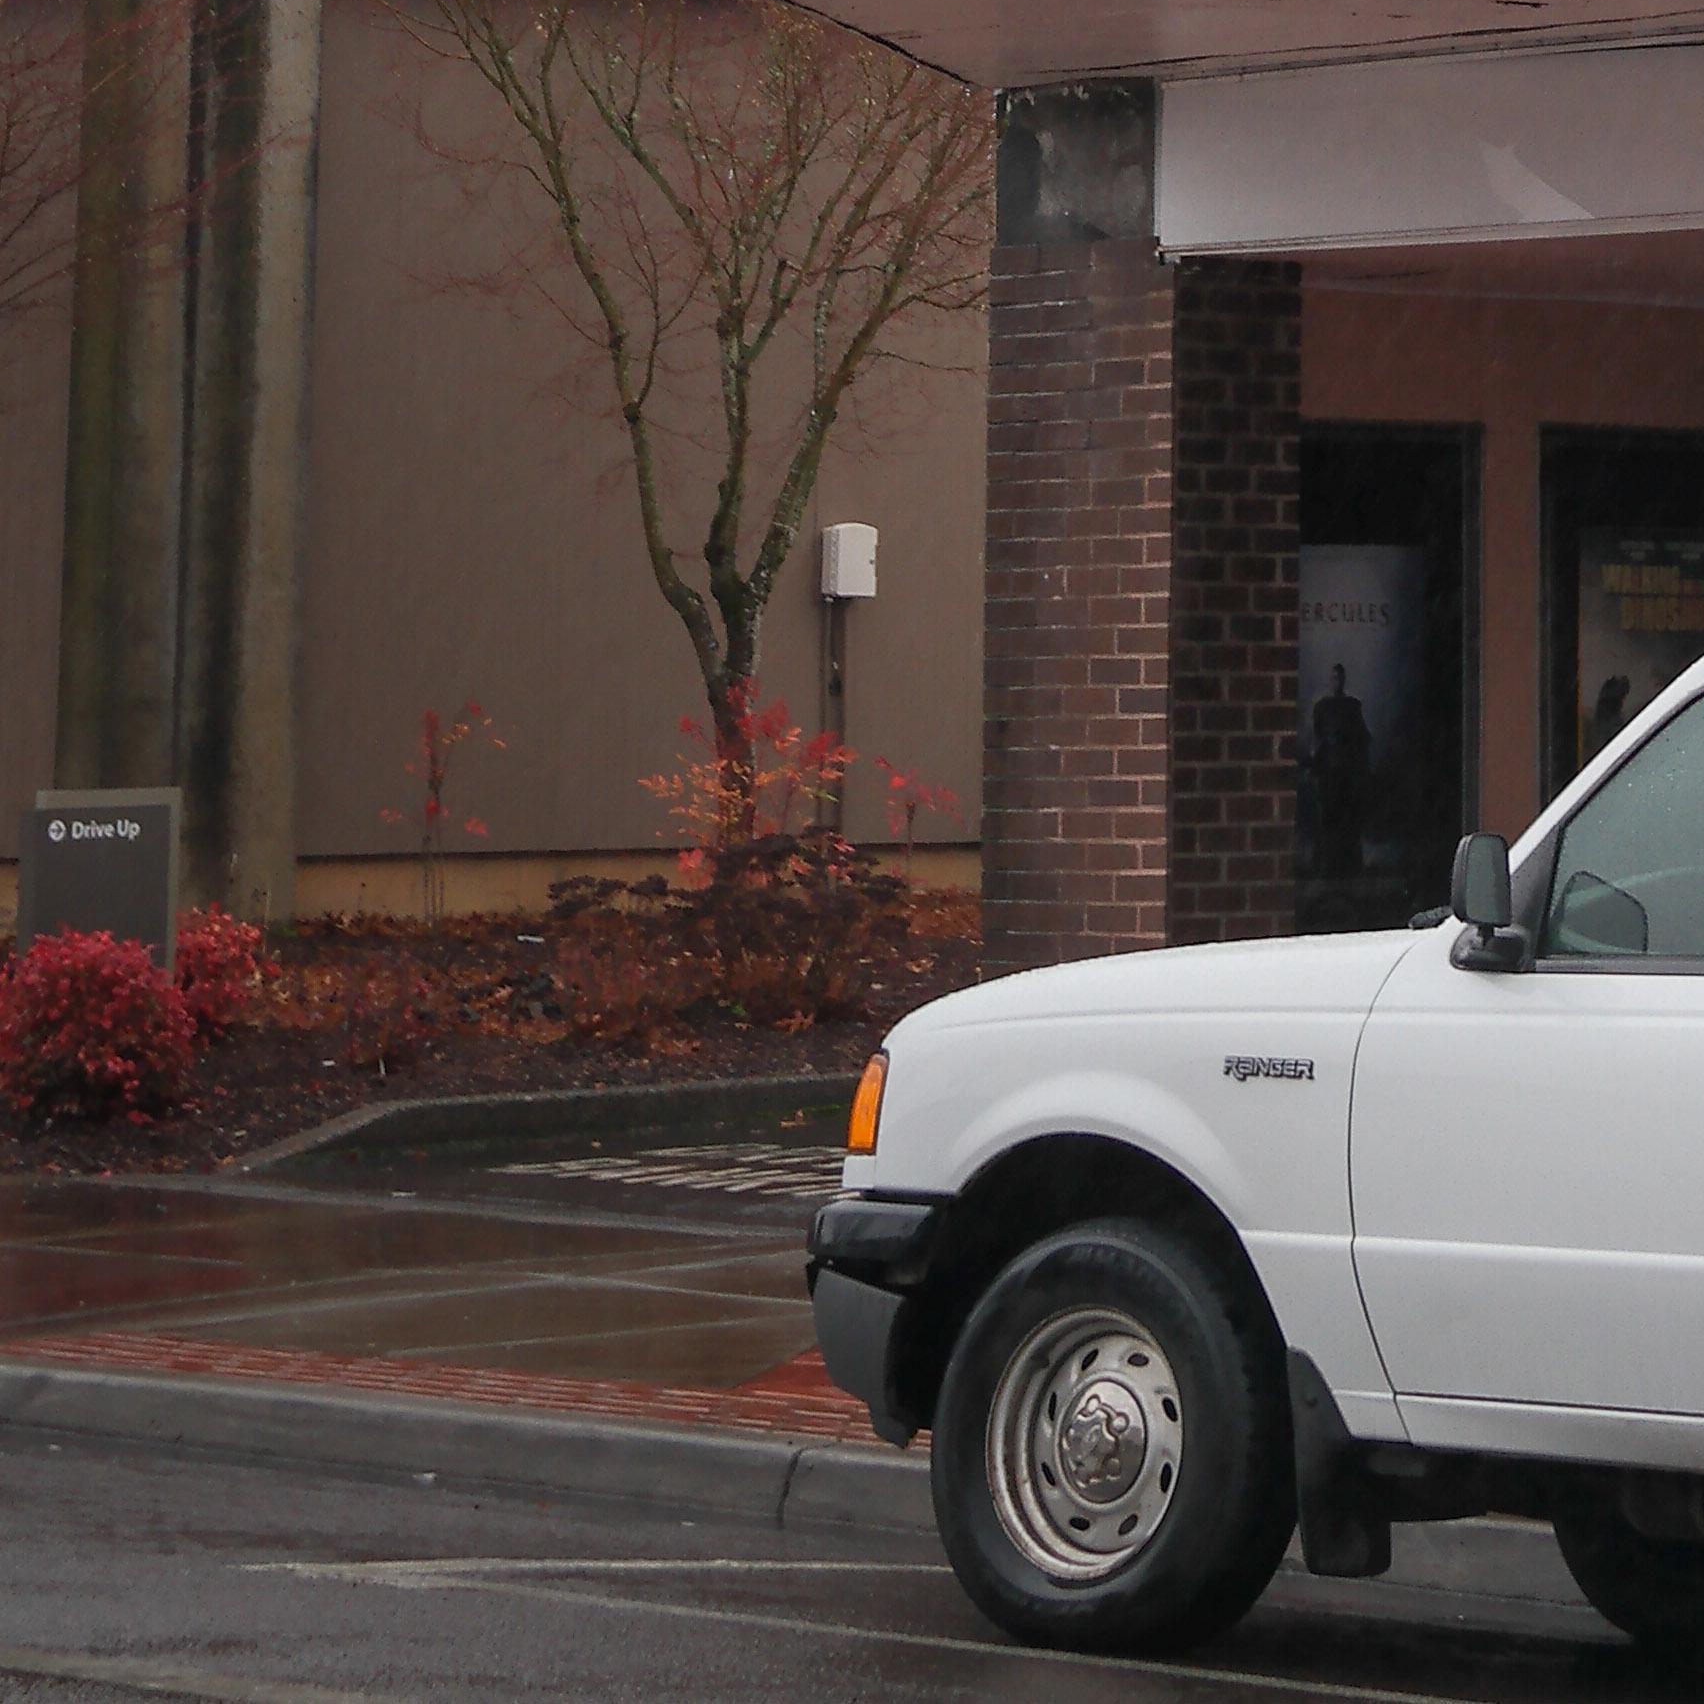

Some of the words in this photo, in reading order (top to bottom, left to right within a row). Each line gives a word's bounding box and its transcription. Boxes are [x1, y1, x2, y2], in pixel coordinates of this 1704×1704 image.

[1300, 601, 1392, 627] ERCULES
[71, 820, 115, 839] Drive
[116, 819, 141, 841] Up
[1223, 1054, 1315, 1082] RANGER
